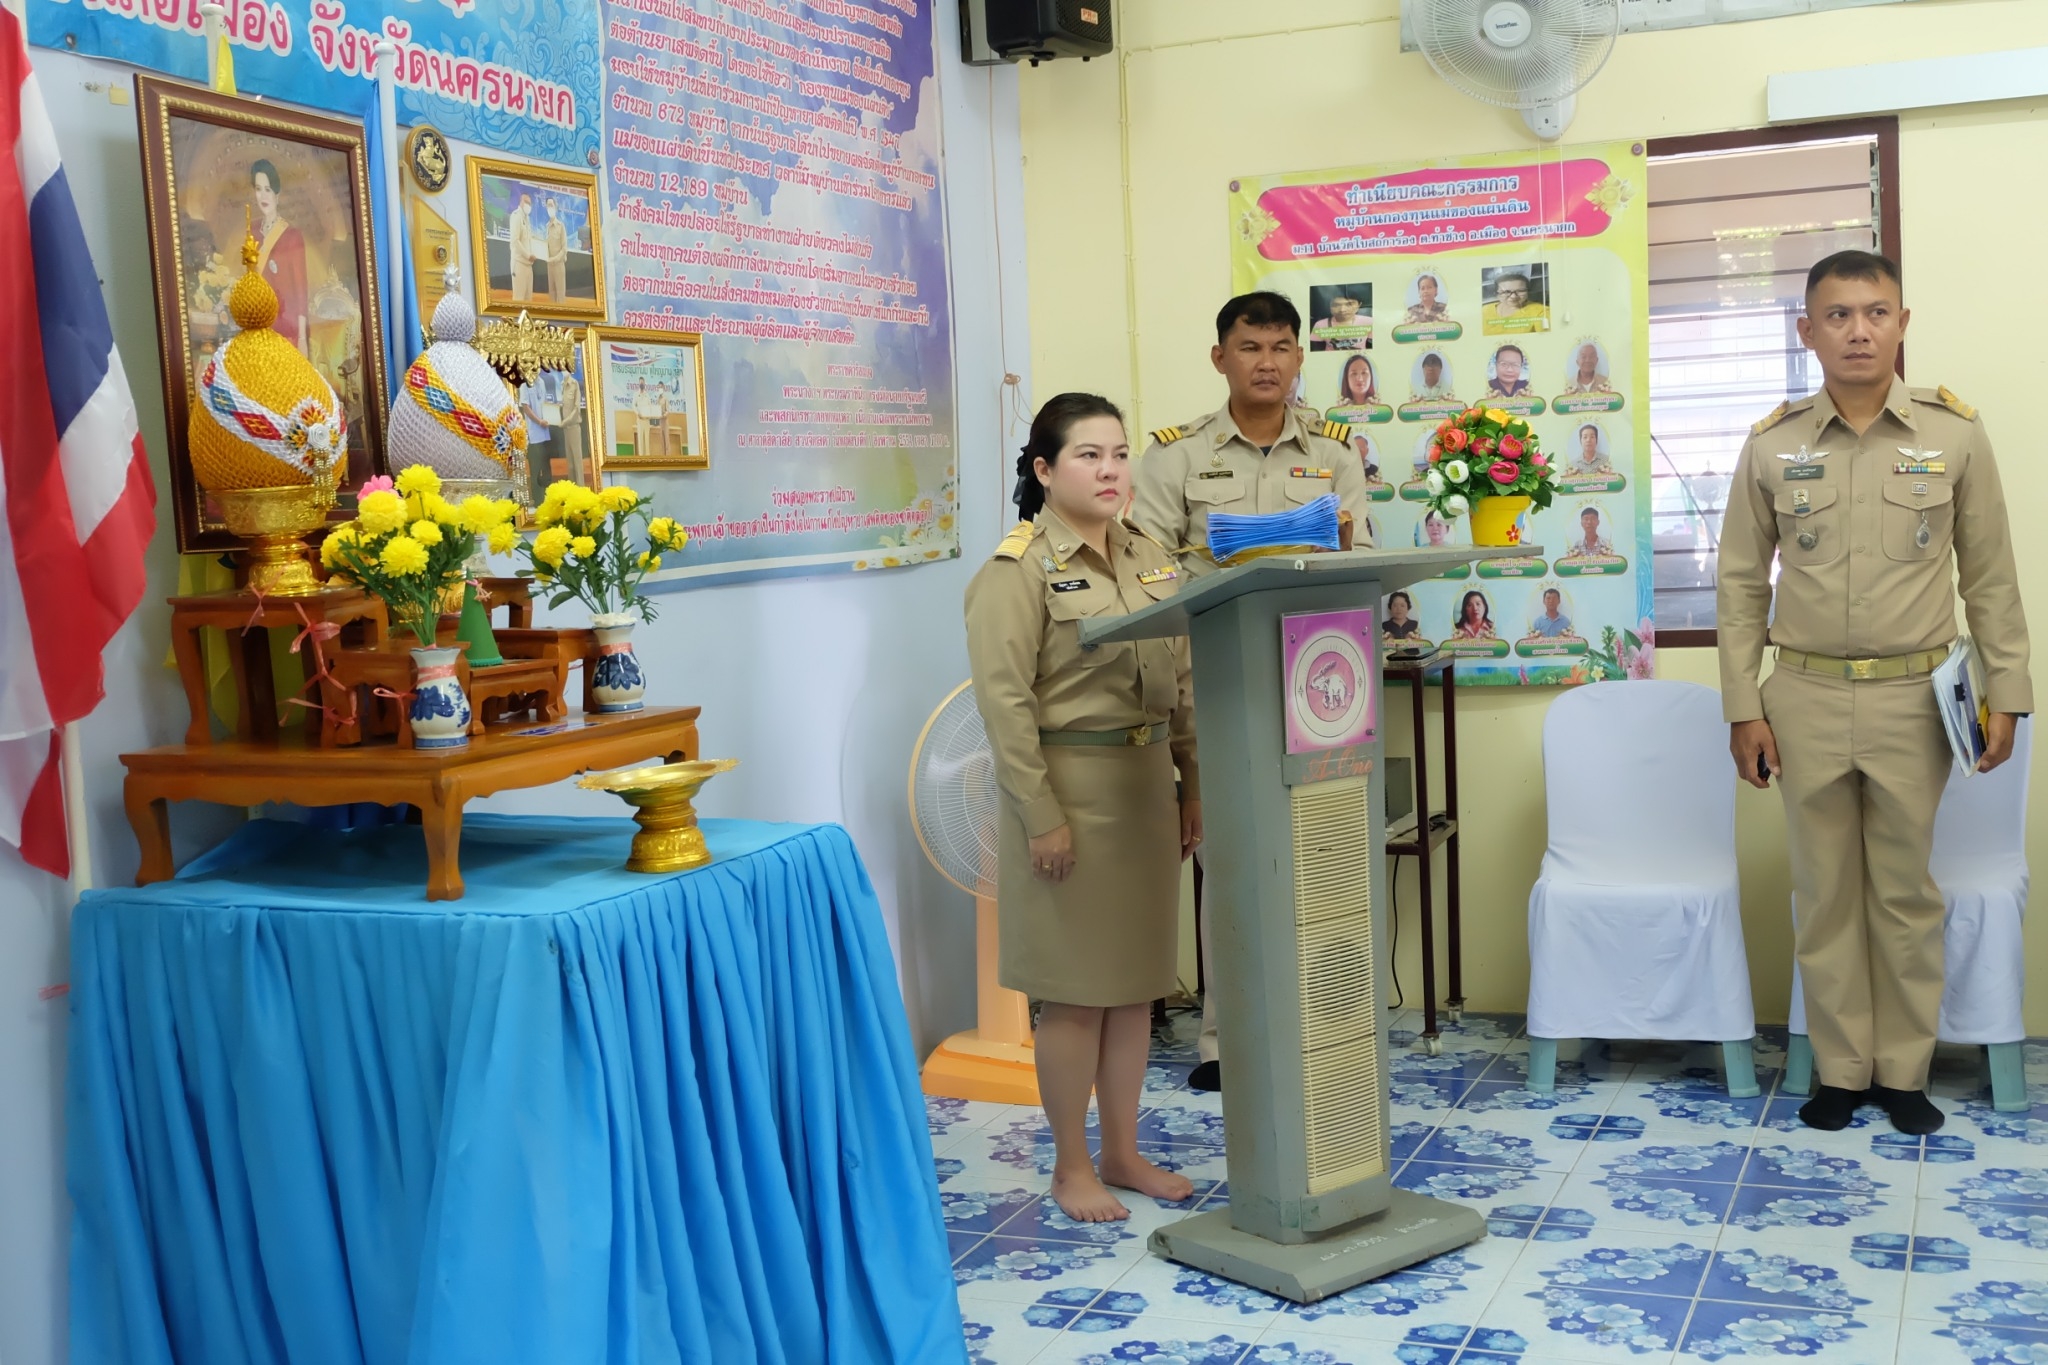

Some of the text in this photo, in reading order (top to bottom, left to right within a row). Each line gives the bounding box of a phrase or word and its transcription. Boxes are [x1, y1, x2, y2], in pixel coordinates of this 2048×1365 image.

[611, 17, 722, 66] ต่อต้านยาเสพติดขึ้น
[613, 88, 651, 117] จำนวน
[659, 104, 684, 123] 672
[689, 109, 728, 135] หมู่บ้าน
[614, 160, 748, 207] จำนวน 12,189 หมู่บ้าน
[1346, 176, 1518, 204] ทำเนียบคณะกรรมการ
[1335, 198, 1529, 229] หมู่บ้านกองทุนแม่ของแผ่นดิน
